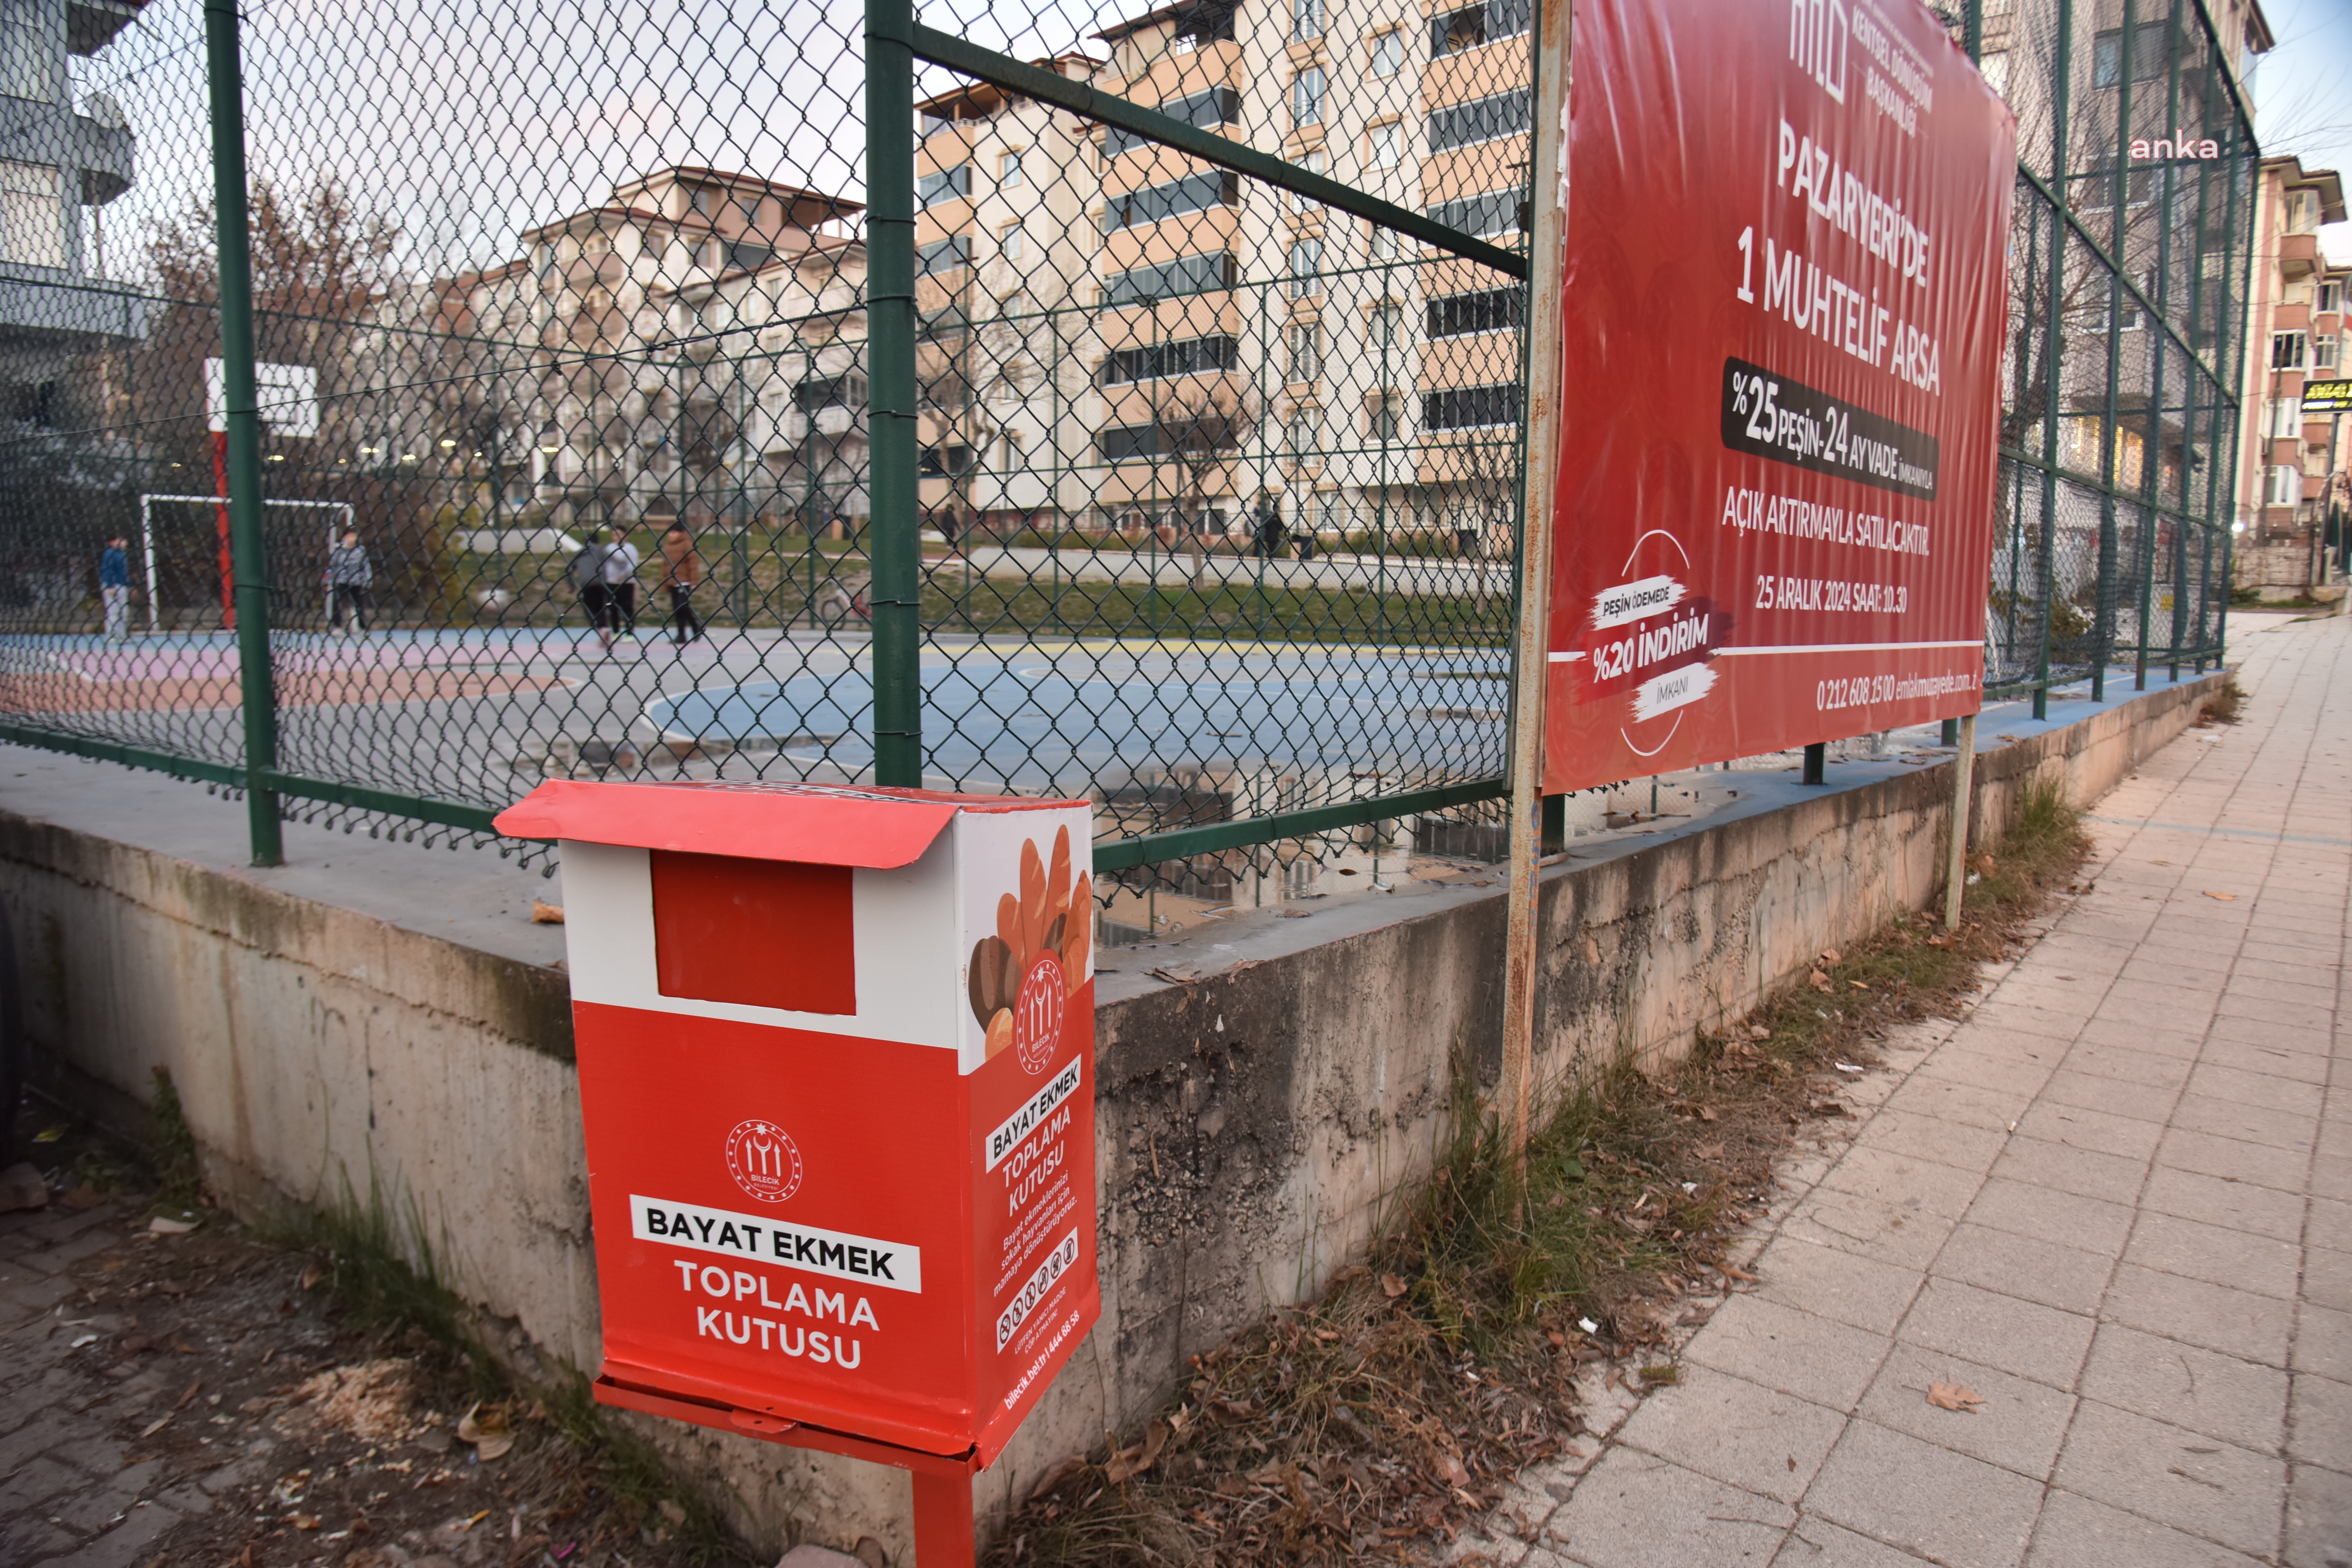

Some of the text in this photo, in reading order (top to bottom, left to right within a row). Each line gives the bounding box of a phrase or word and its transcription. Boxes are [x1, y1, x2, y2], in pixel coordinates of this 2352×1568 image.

[1737, 225, 1940, 397] 1 MUHTELİF ARSA
[1732, 371, 1779, 443] %25
[1848, 434, 1868, 470] AY
[1868, 441, 1898, 480] VADE
[1722, 486, 1764, 537] AÇIK
[1765, 495, 1853, 545] ARTIRMAYLA
[1603, 586, 1670, 618] PEŞİN ÖDEMEDE
[1755, 575, 1907, 614] 25 ARALIK 2024 SAAT: 10.30
[1593, 607, 1709, 683] %20 İNDİRİM
[1657, 675, 1689, 704] İMKANI
[1816, 680, 1825, 711] 0
[1826, 678, 1848, 709] 212
[1849, 676, 1870, 706] 608
[1032, 1032, 1050, 1053] BİLECİK
[994, 1063, 1078, 1160] BAYAT EKMEK
[1003, 1105, 1071, 1188] TOPLAMA
[751, 1173, 780, 1185] BİLECİK
[1003, 1170, 1068, 1251] Bayat ekmeklerinizi
[1009, 1140, 1064, 1217] KUTUSU
[646, 1207, 896, 1281] BAYAT EKMEK
[994, 1196, 1078, 1298] mamaya dönüştürüyoruz.
[1001, 1187, 1070, 1271] sokak hayvanları için
[673, 1260, 880, 1332] TOPLAMA
[1015, 1286, 1066, 1355] LÜTFEN YANICI MADDE
[1024, 1308, 1058, 1355] ÇÖP ATMAYIN!
[697, 1306, 861, 1369] KUTUSU
[1004, 1310, 1080, 1410] bilecik.bel.tr 444 88 58
